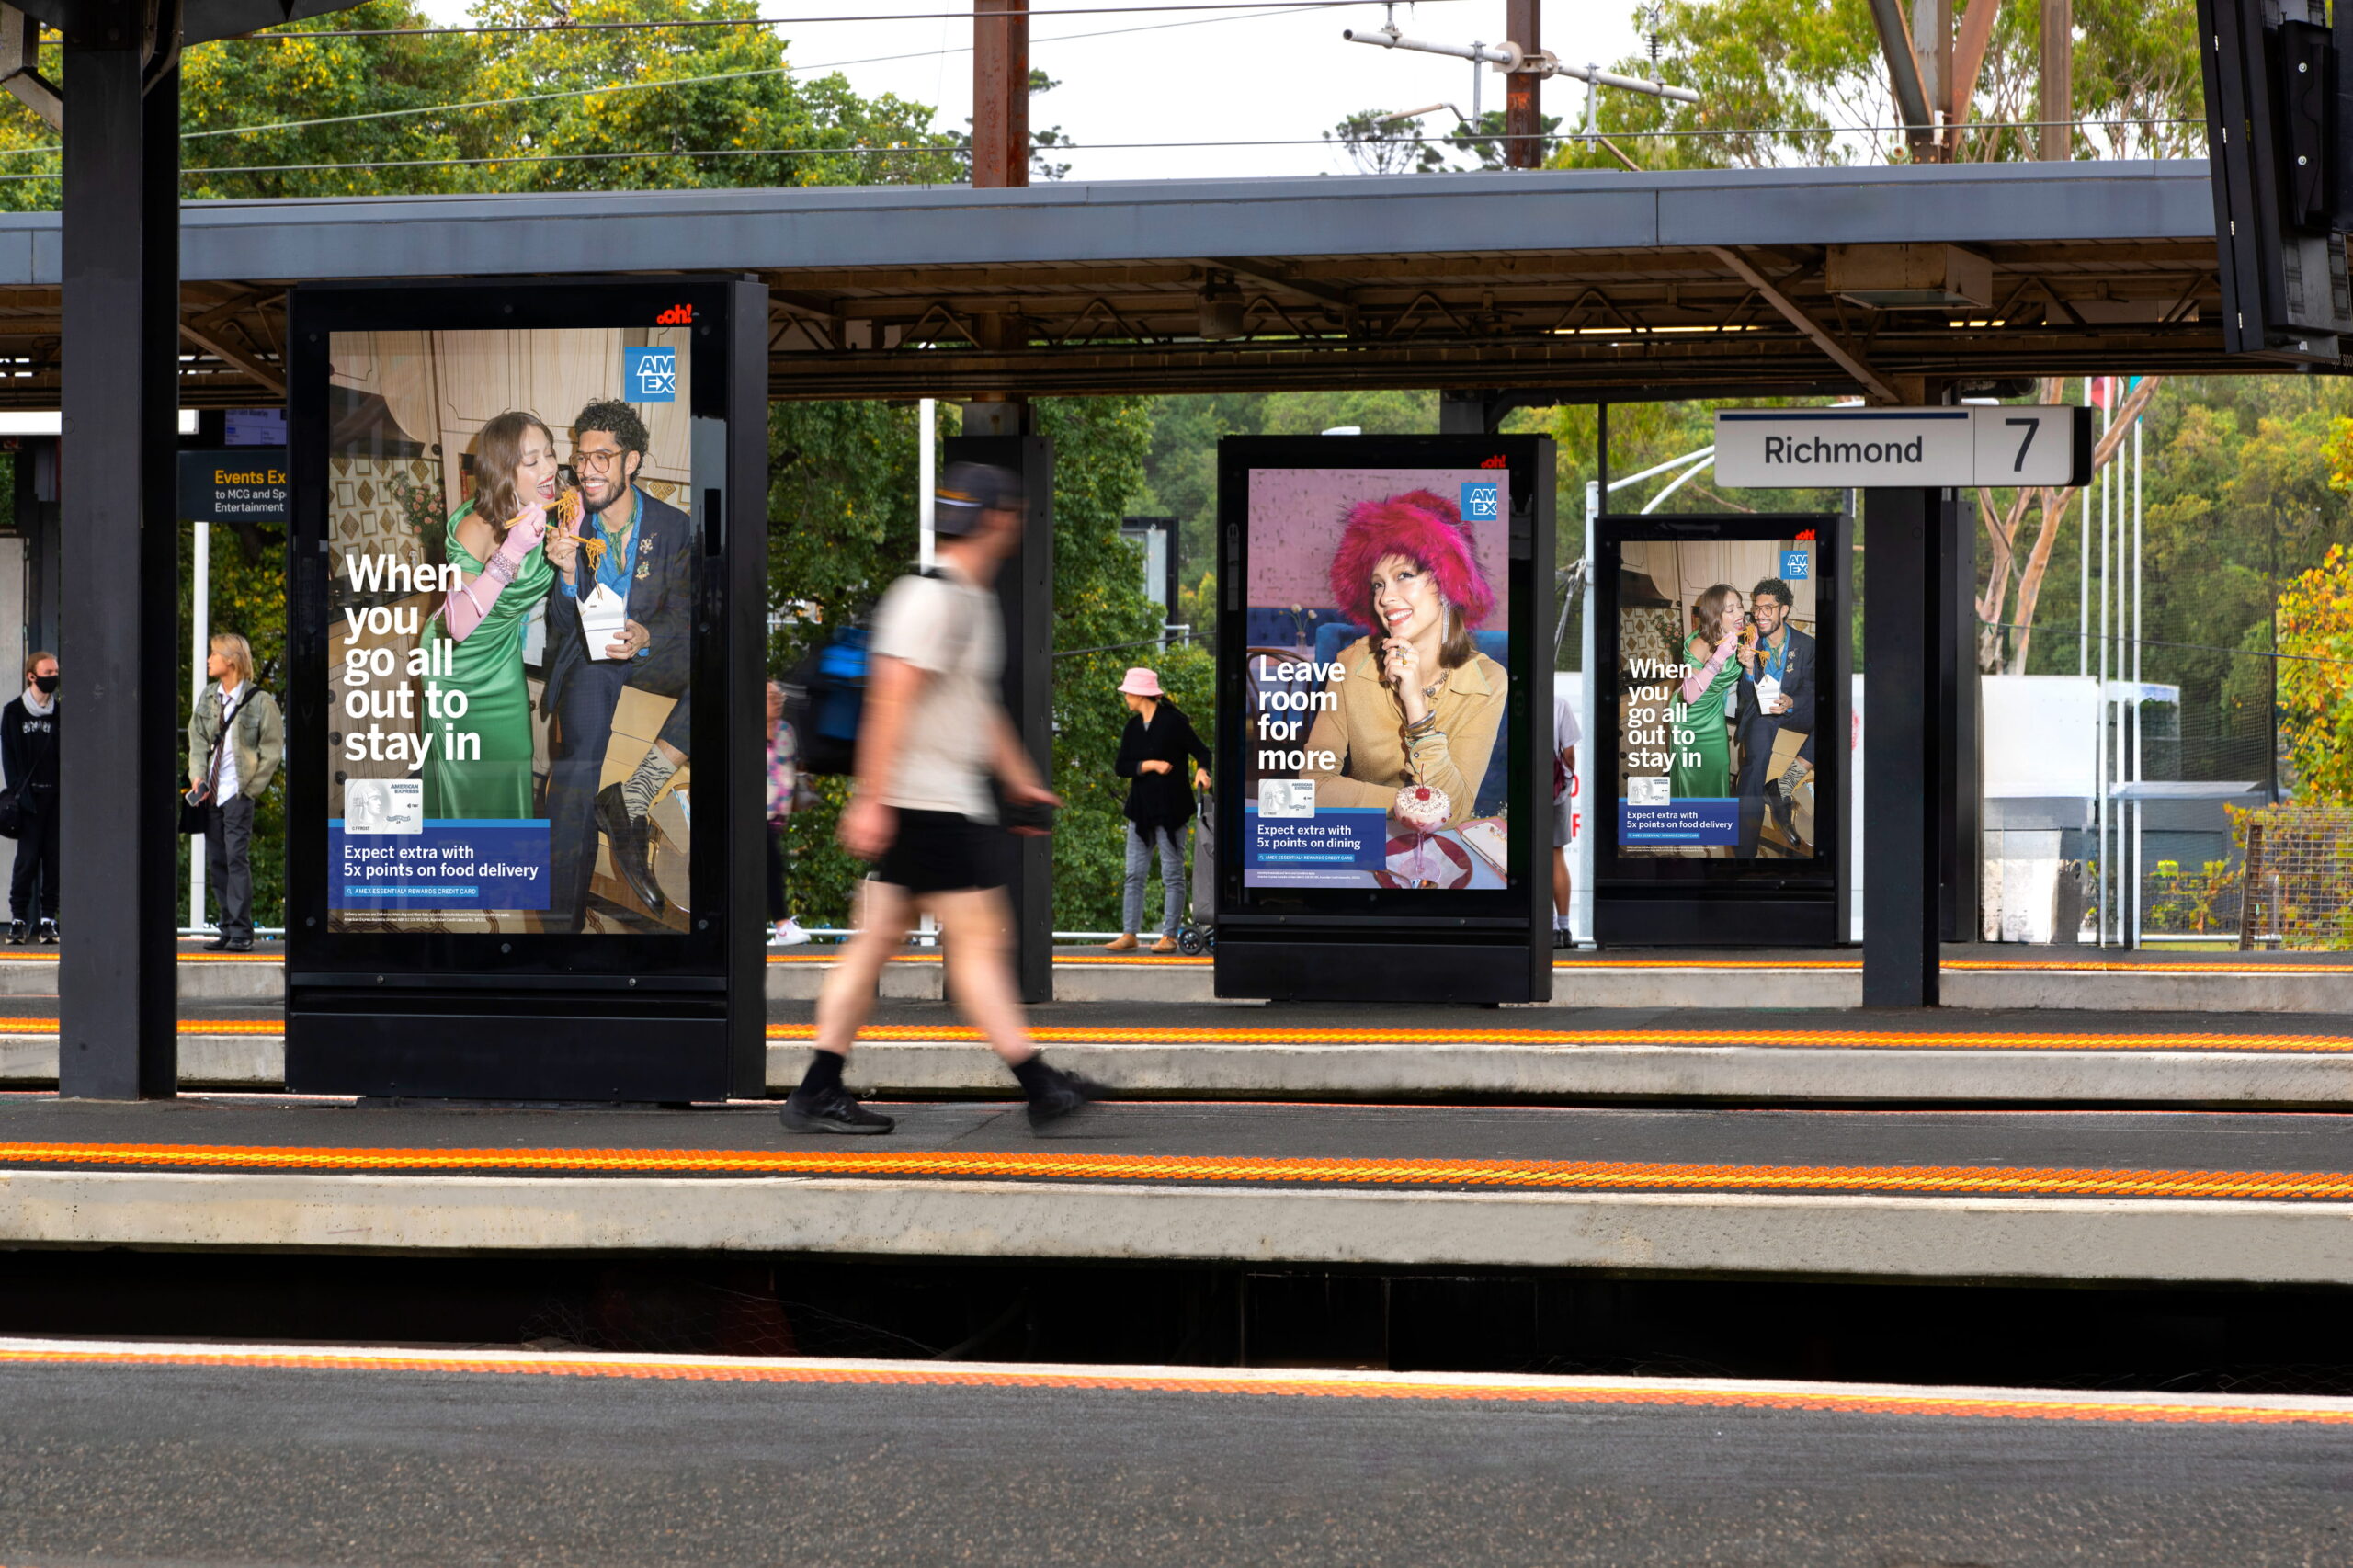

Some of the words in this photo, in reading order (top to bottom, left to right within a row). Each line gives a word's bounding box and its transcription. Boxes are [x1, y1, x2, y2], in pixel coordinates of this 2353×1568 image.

[1764, 435, 1923, 464] Richmond
[2005, 417, 2040, 472] 7
[215, 470, 264, 484] Events
[215, 490, 226, 500] to
[228, 489, 250, 499] MCG
[252, 489, 270, 499] and
[272, 489, 287, 502] Sp
[215, 502, 284, 513] Entertainment
[346, 553, 462, 592] When
[344, 605, 418, 645] you
[343, 647, 395, 687] go
[406, 638, 453, 676] all
[1258, 654, 1346, 682] Leave
[1629, 658, 1692, 679] When
[345, 681, 415, 719] out
[425, 681, 468, 719] to
[1258, 690, 1338, 711] room
[1628, 686, 1669, 706] you
[1627, 708, 1656, 728] go
[1661, 702, 1688, 723] all
[1257, 713, 1302, 741] for
[1628, 725, 1665, 745] out
[1673, 724, 1695, 745] to
[344, 723, 434, 771] stay
[445, 722, 481, 761] in
[1258, 749, 1336, 770] more
[1627, 748, 1676, 772] stay
[1682, 747, 1702, 767] in
[1627, 811, 1655, 821] Expect
[1680, 811, 1699, 819] with
[1639, 821, 1665, 830] points
[1699, 821, 1733, 831] delivery
[1257, 824, 1295, 836] Expect
[1297, 825, 1325, 835] extra
[1328, 824, 1352, 835] with
[344, 845, 395, 862] Expect
[399, 846, 438, 859] extra
[442, 845, 474, 859] with
[1257, 837, 1270, 847] 5x
[1273, 838, 1308, 849] points
[1326, 838, 1361, 850] dining
[343, 862, 361, 877] 5x
[366, 863, 413, 880] points
[417, 866, 436, 877] on
[440, 862, 474, 877] food
[478, 862, 539, 881] delivery
